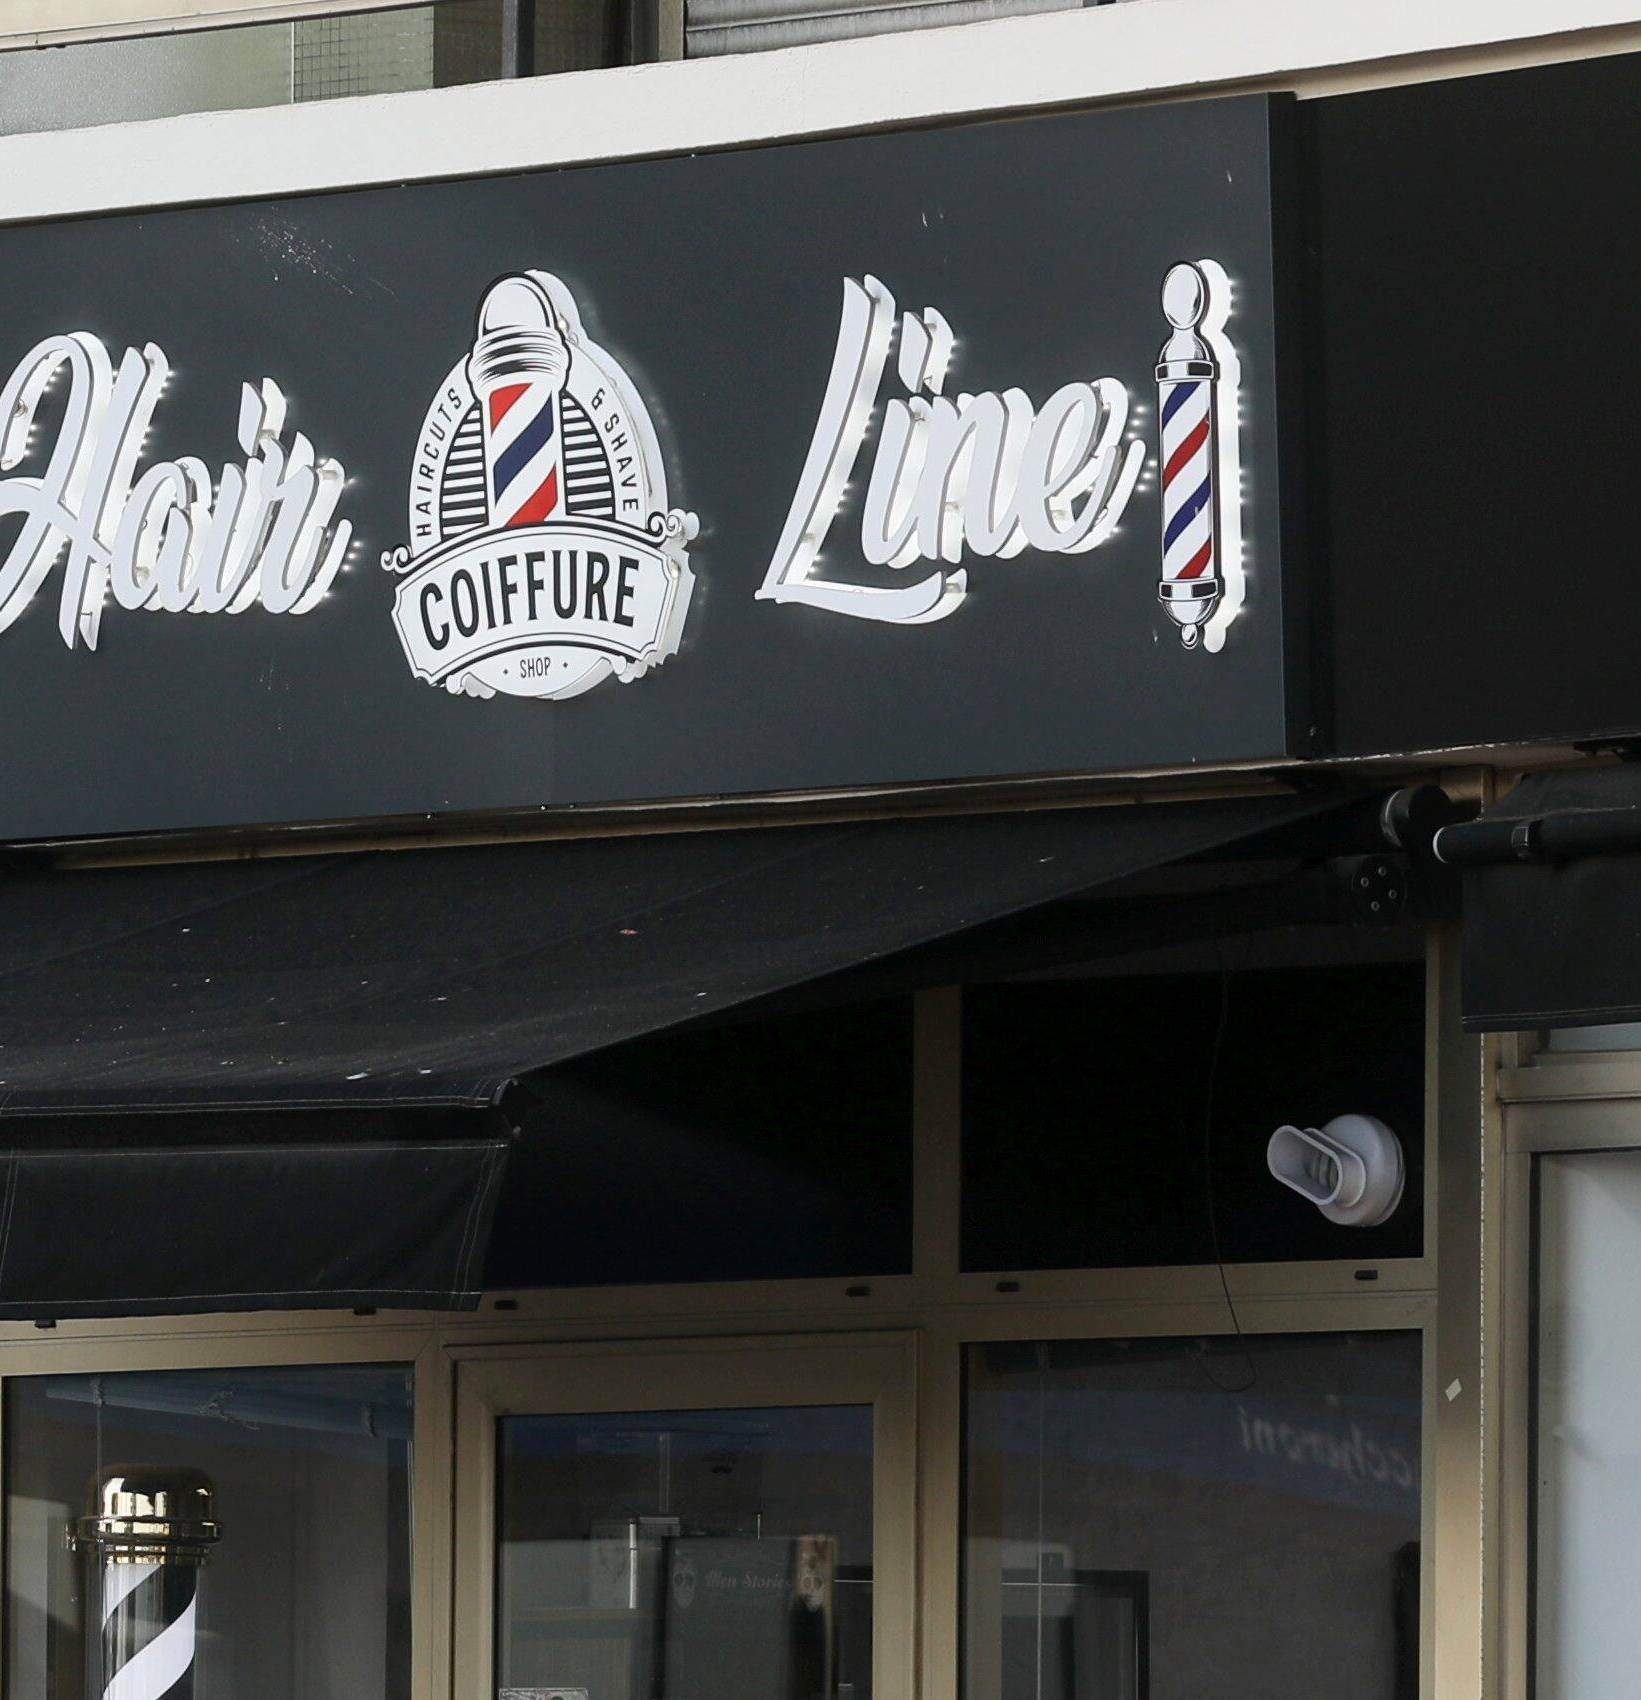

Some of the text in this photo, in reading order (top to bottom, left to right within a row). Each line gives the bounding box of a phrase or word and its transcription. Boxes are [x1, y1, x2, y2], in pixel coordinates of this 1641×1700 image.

[416, 387, 463, 537] HAIRCUTS
[604, 412, 640, 512] SHAVE
[755, 272, 1147, 624] Line
[419, 549, 640, 650] COIFFURE
[519, 655, 552, 679] SHOP
